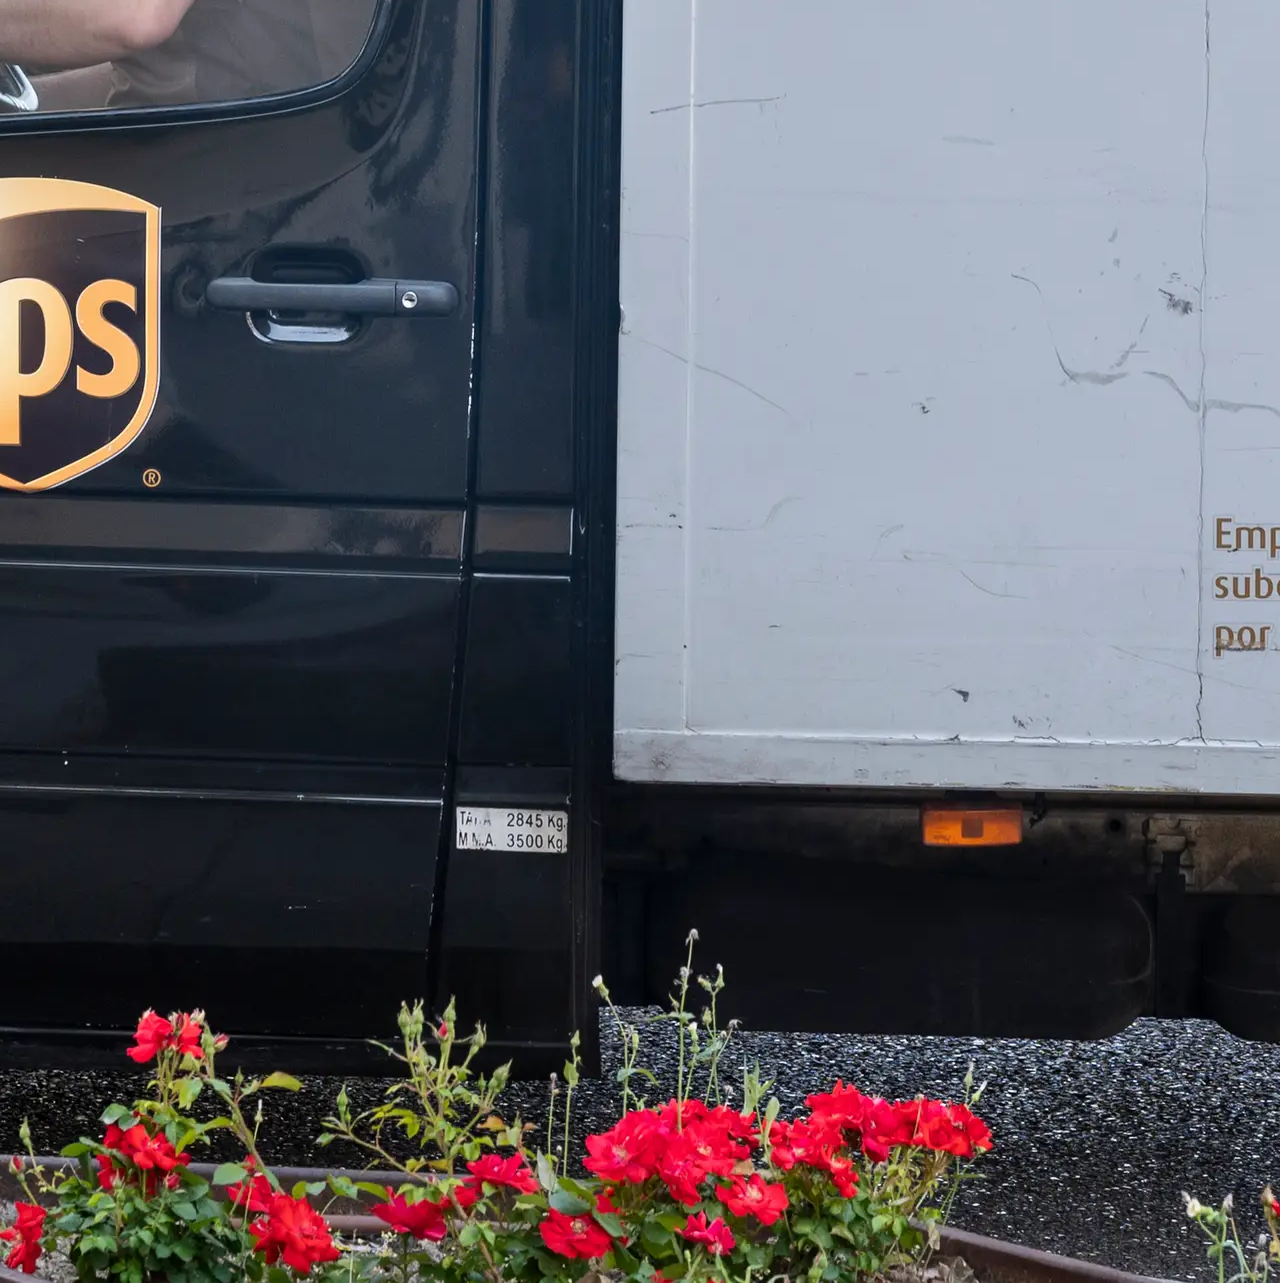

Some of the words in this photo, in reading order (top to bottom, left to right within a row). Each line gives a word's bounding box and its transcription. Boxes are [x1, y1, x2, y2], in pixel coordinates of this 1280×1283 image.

[1214, 625, 1272, 657] por
[506, 812, 543, 828] 2845
[506, 833, 543, 848] 3500
